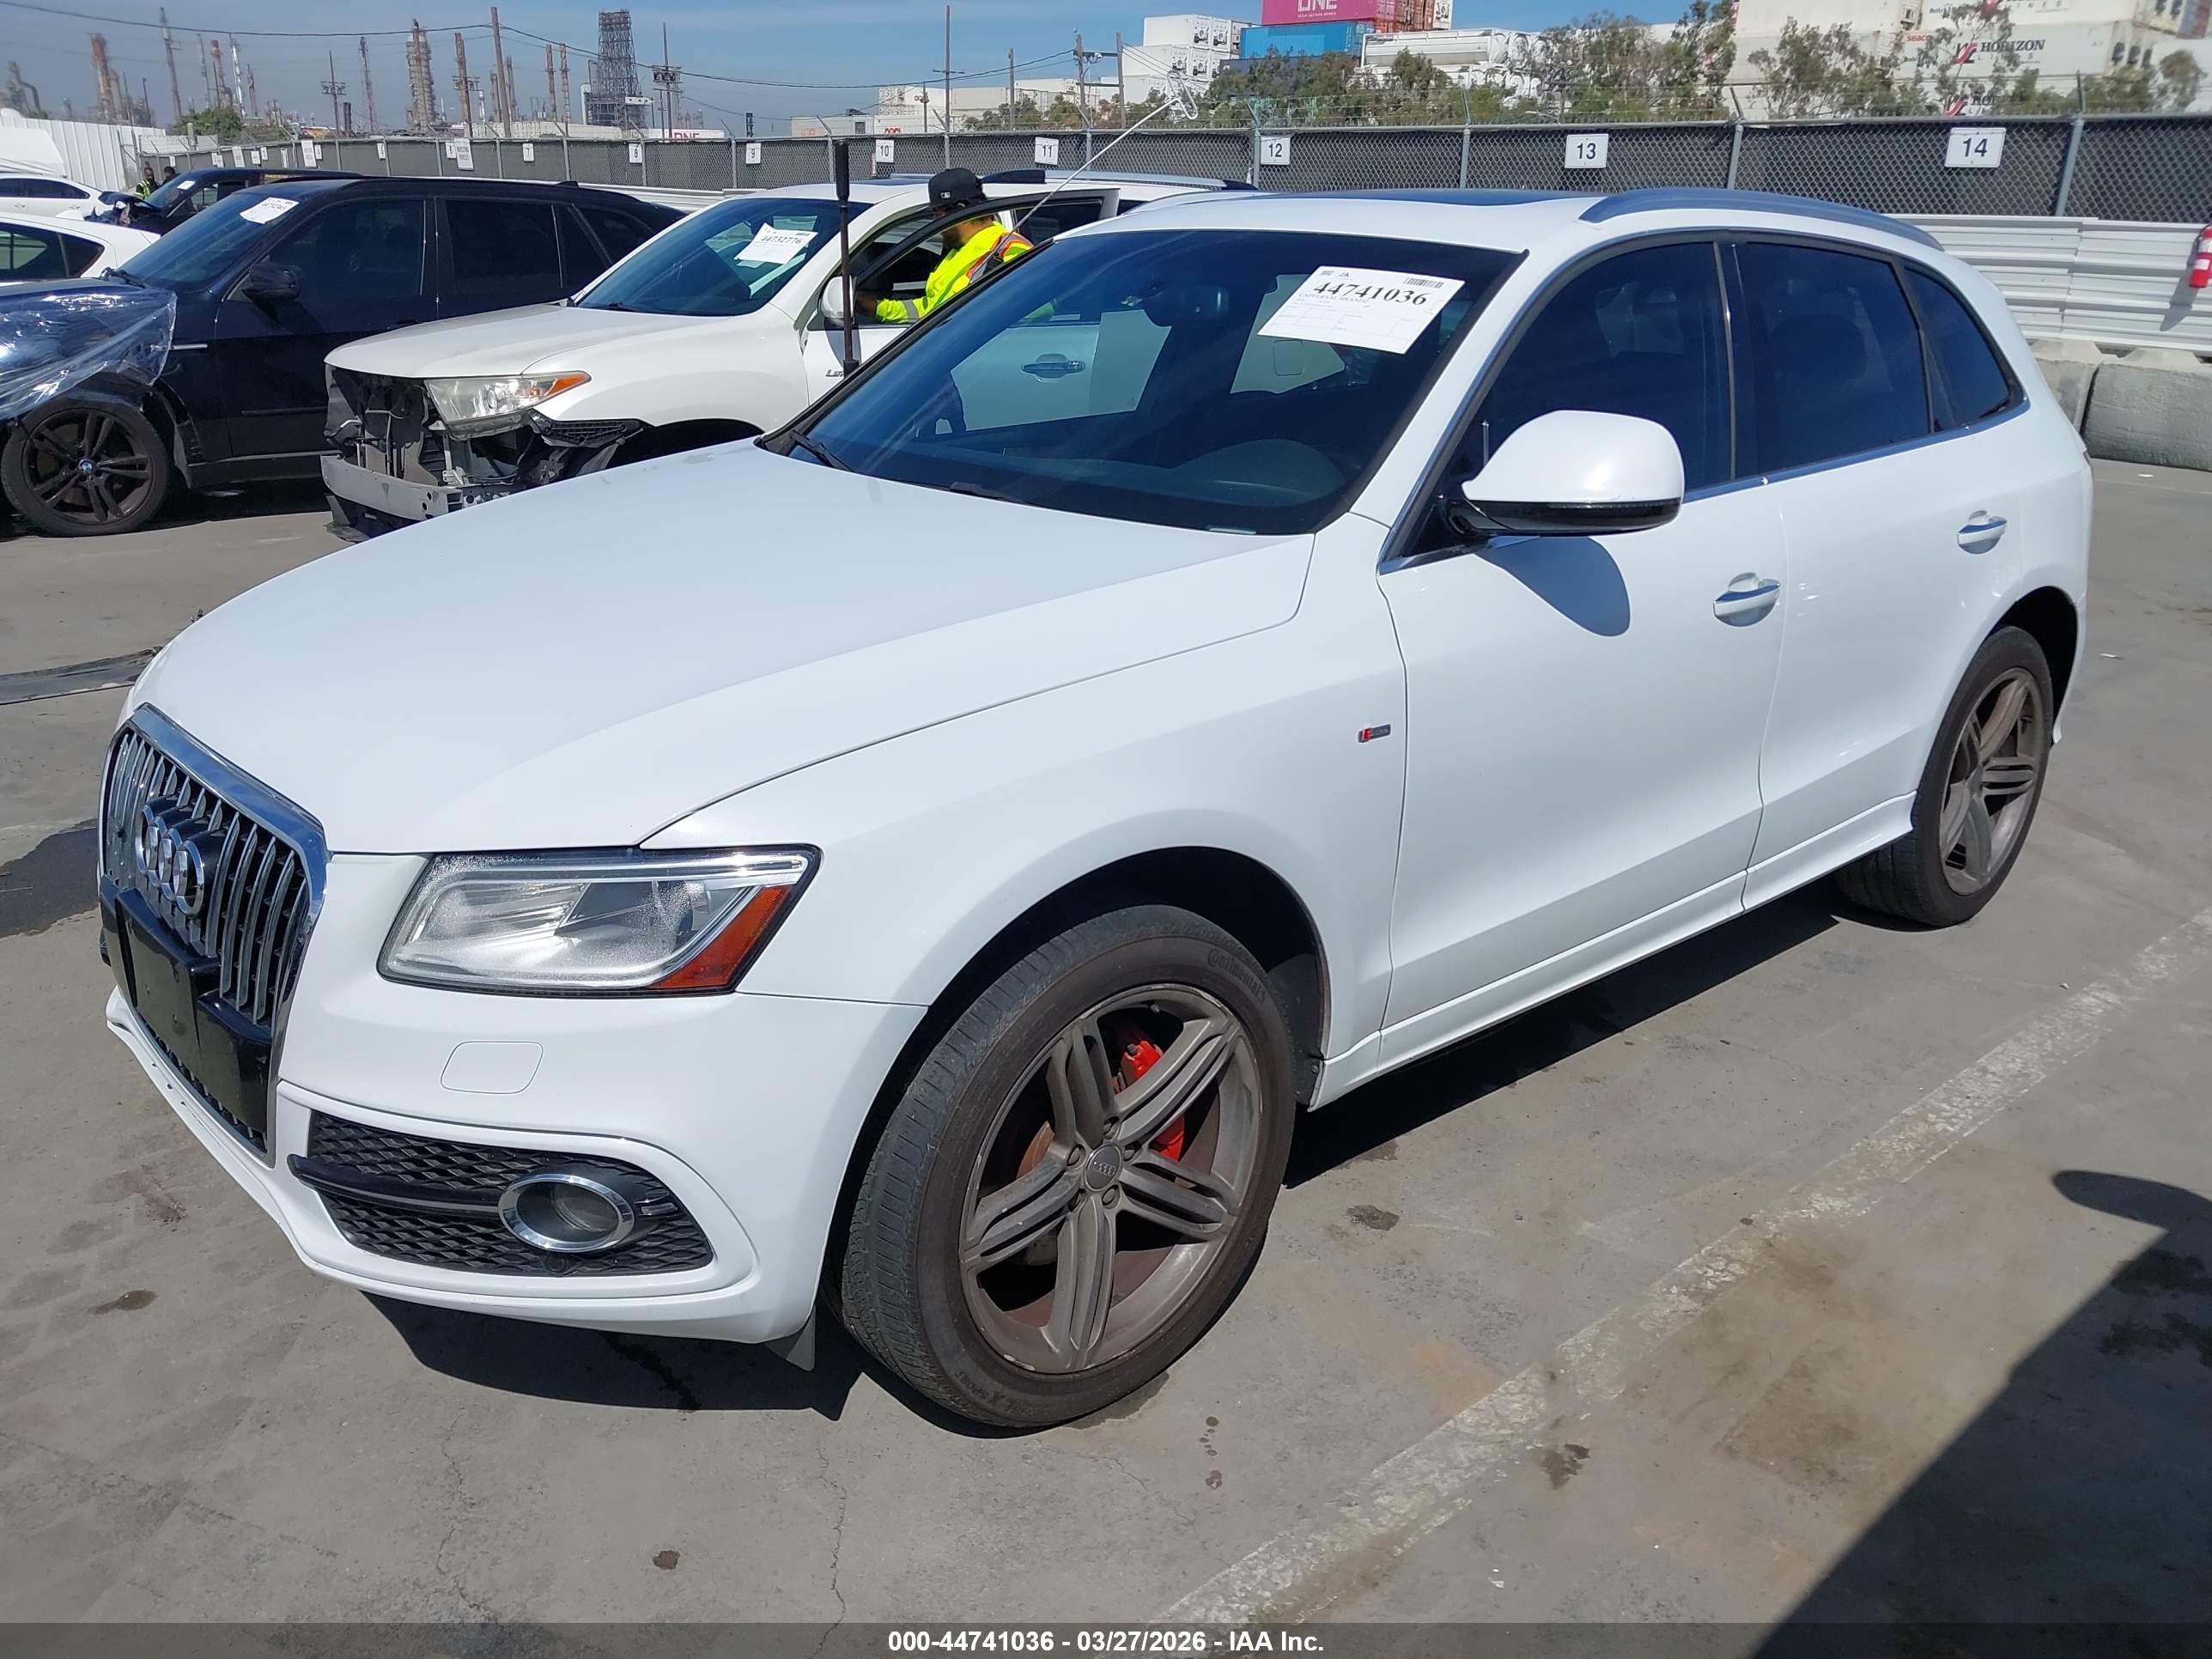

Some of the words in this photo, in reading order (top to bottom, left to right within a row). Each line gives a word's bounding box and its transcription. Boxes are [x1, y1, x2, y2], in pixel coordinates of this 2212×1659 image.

[750, 148, 756, 159] 9
[880, 145, 890, 157] 10
[1042, 144, 1052, 157] 11
[1268, 143, 1283, 158] 12
[1577, 143, 1596, 160] 13
[1963, 138, 1988, 157] 14
[1313, 282, 1433, 306] 44741036
